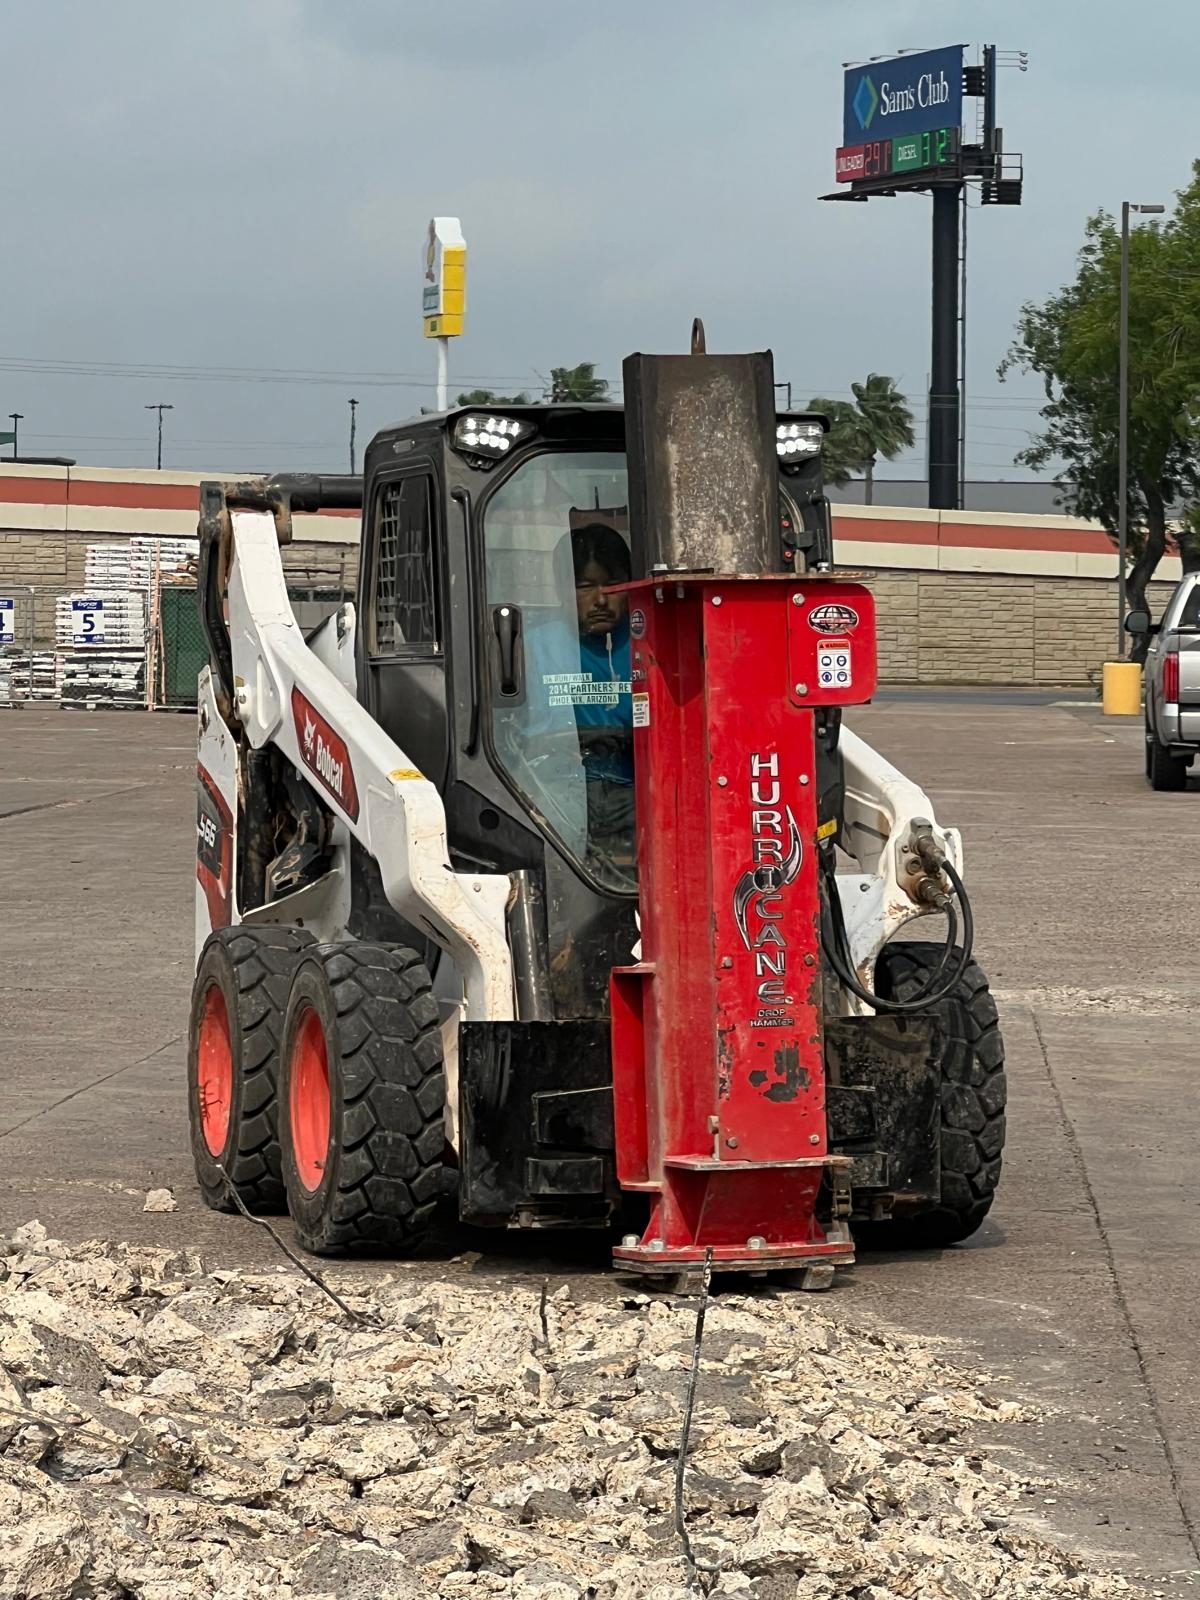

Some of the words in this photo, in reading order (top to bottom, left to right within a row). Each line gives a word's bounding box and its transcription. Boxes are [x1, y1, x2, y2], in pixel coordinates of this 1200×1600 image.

[881, 82, 915, 115] Sam's
[918, 71, 949, 107] Club
[898, 145, 918, 161] DIESEL
[83, 613, 95, 632] 5
[549, 685, 569, 696] 2014
[618, 682, 632, 693] RE
[586, 694, 618, 704] ARIZONA
[316, 734, 344, 796] Bobcat
[751, 752, 787, 1005] HURRICANE
[758, 1008, 786, 1018] DROP
[750, 1018, 794, 1028] HAMMER
